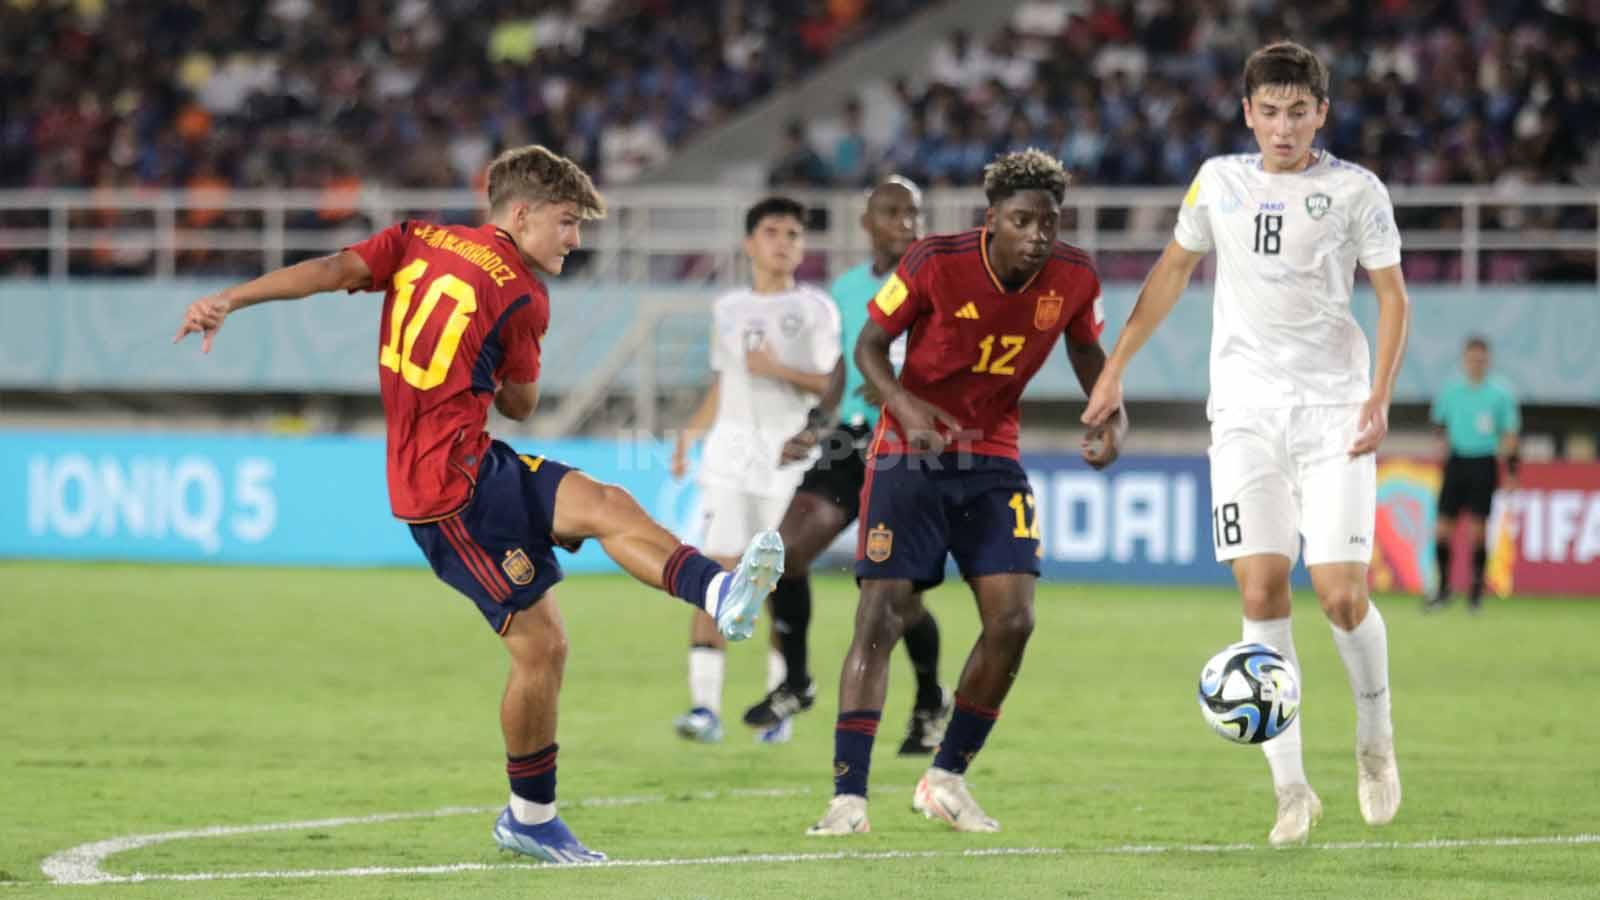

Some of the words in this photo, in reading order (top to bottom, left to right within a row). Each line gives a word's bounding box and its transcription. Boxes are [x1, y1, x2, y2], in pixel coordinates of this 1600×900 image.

[1254, 213, 1283, 255] 18
[380, 258, 478, 391] 10
[971, 334, 1025, 376] 12
[27, 454, 224, 554] IONIQ
[231, 457, 278, 541] 5
[1214, 502, 1242, 547] 18
